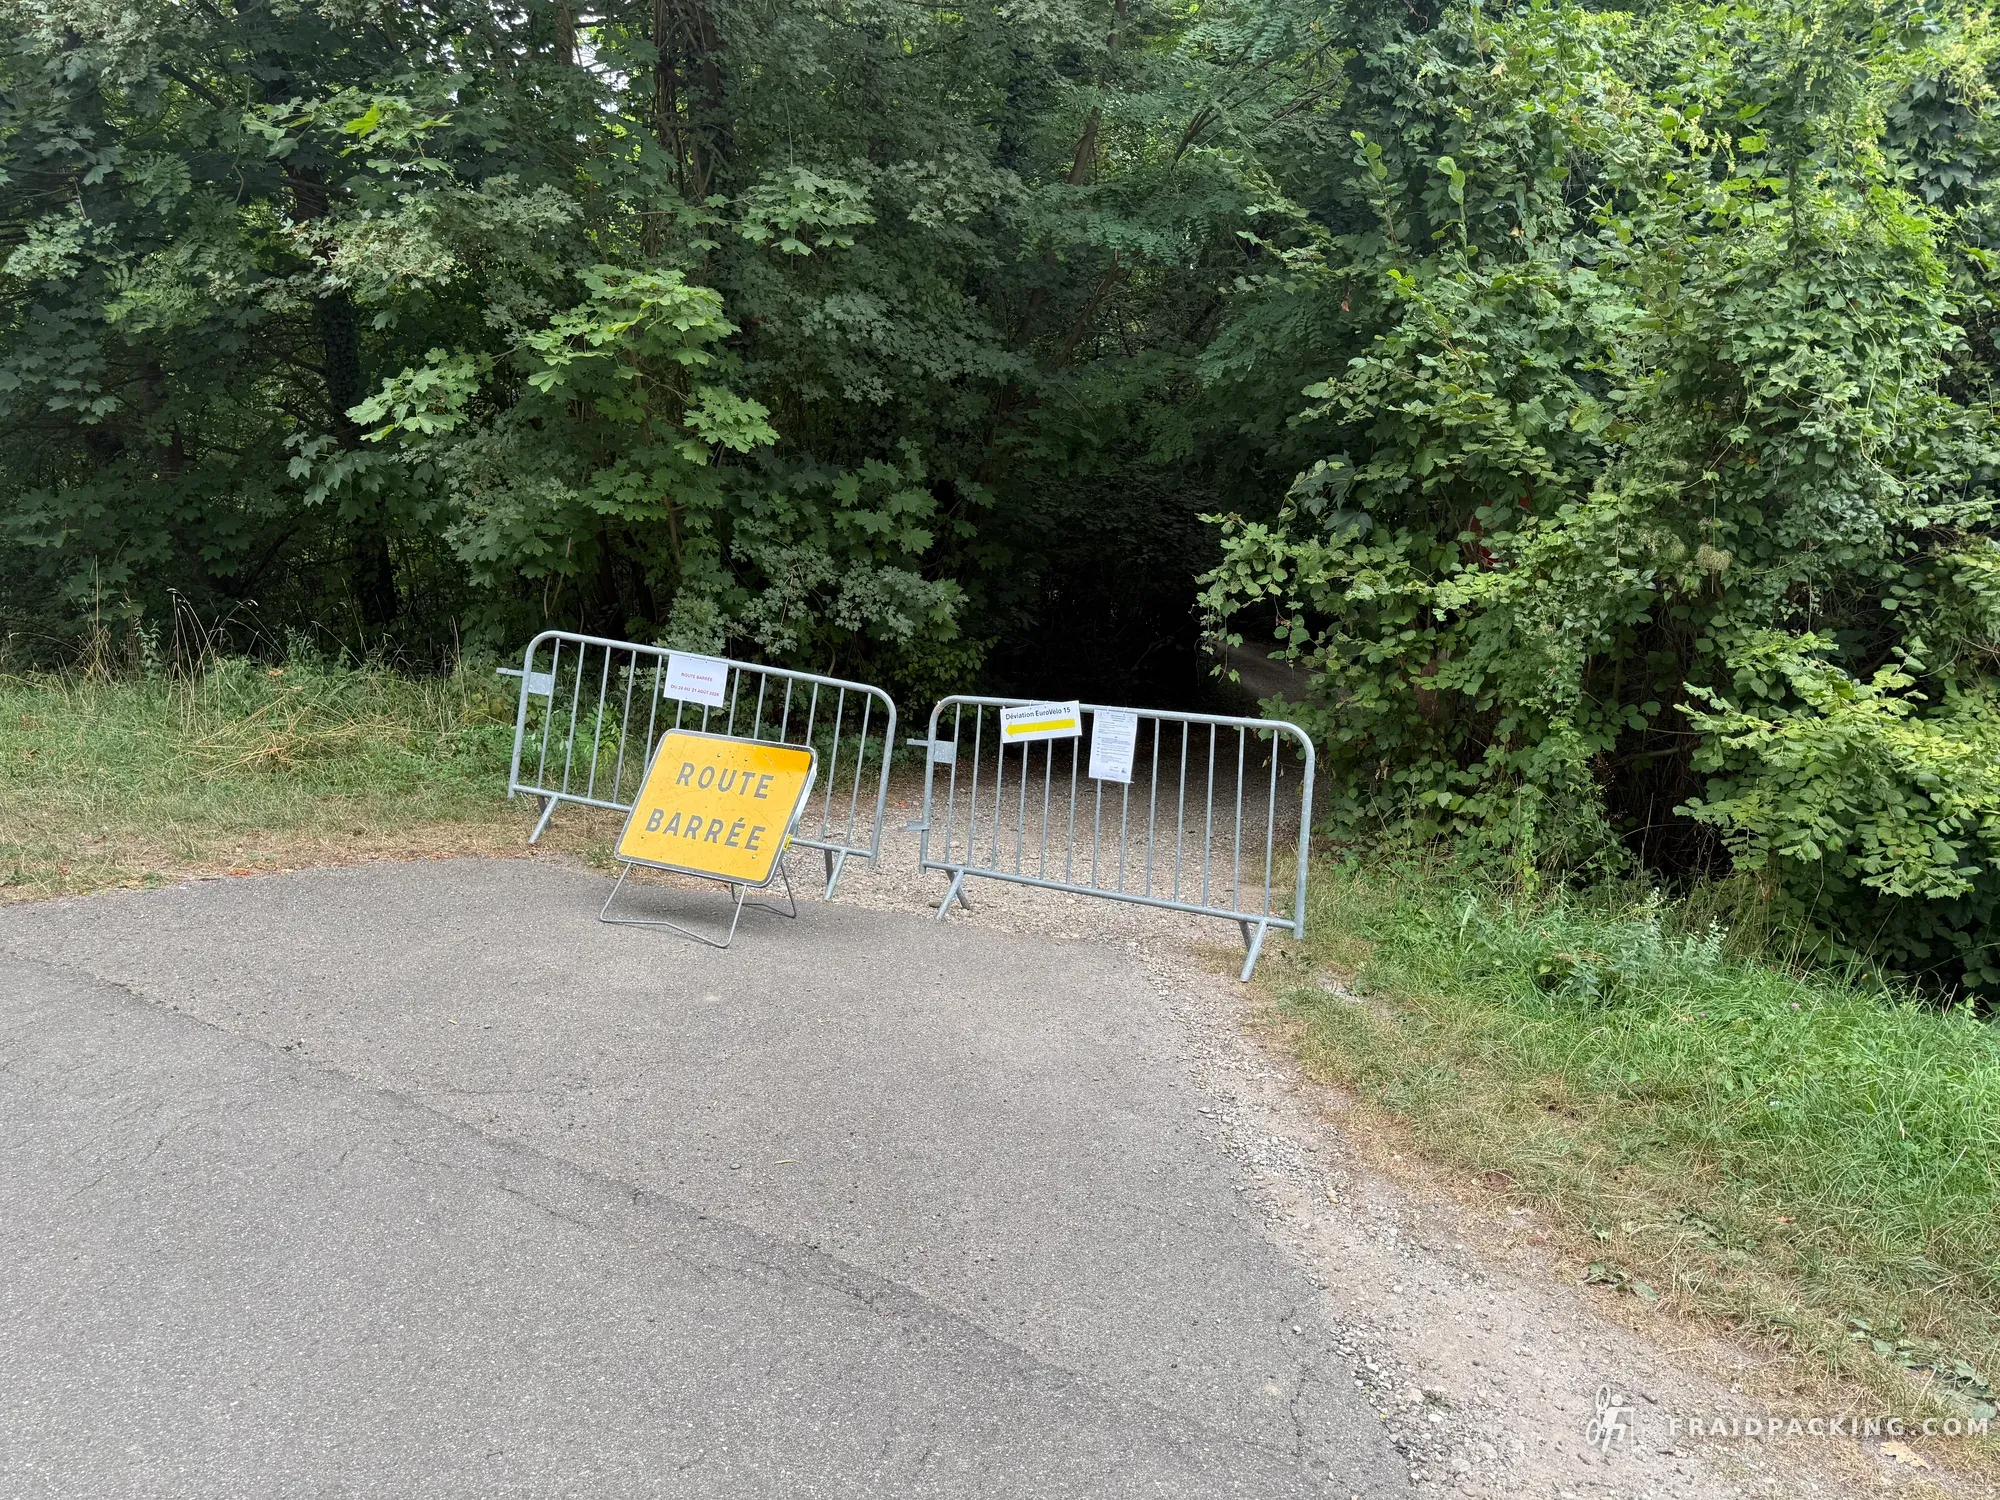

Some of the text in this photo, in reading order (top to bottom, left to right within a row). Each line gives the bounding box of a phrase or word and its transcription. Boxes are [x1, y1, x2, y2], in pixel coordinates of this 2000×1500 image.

[1005, 711, 1034, 720] Déviation
[1063, 706, 1071, 714] 15
[675, 762, 774, 799] ROUTE
[645, 808, 766, 851] BARRÉE
